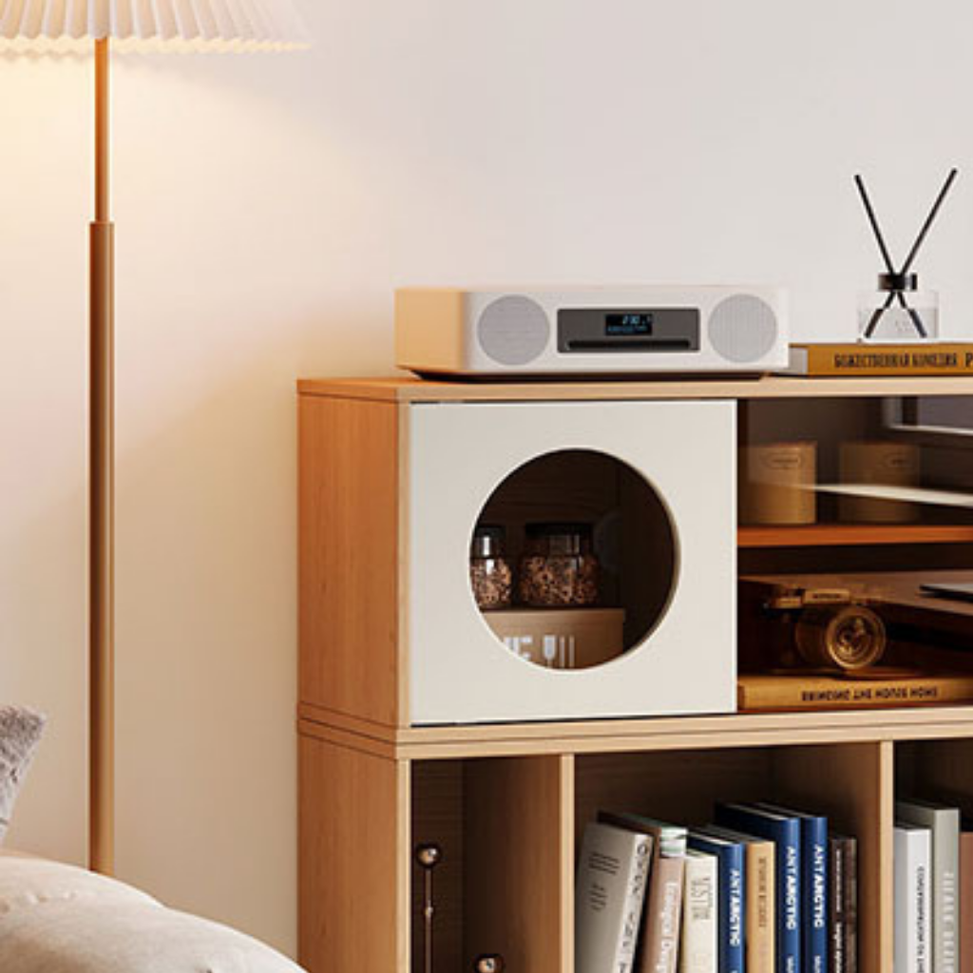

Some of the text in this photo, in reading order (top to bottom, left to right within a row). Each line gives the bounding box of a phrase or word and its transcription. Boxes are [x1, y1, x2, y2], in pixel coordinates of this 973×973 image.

[729, 868, 741, 947] ANTARCTIC
[785, 846, 797, 930] ANTARCTIC
[813, 844, 825, 928] ANTARCTIC
